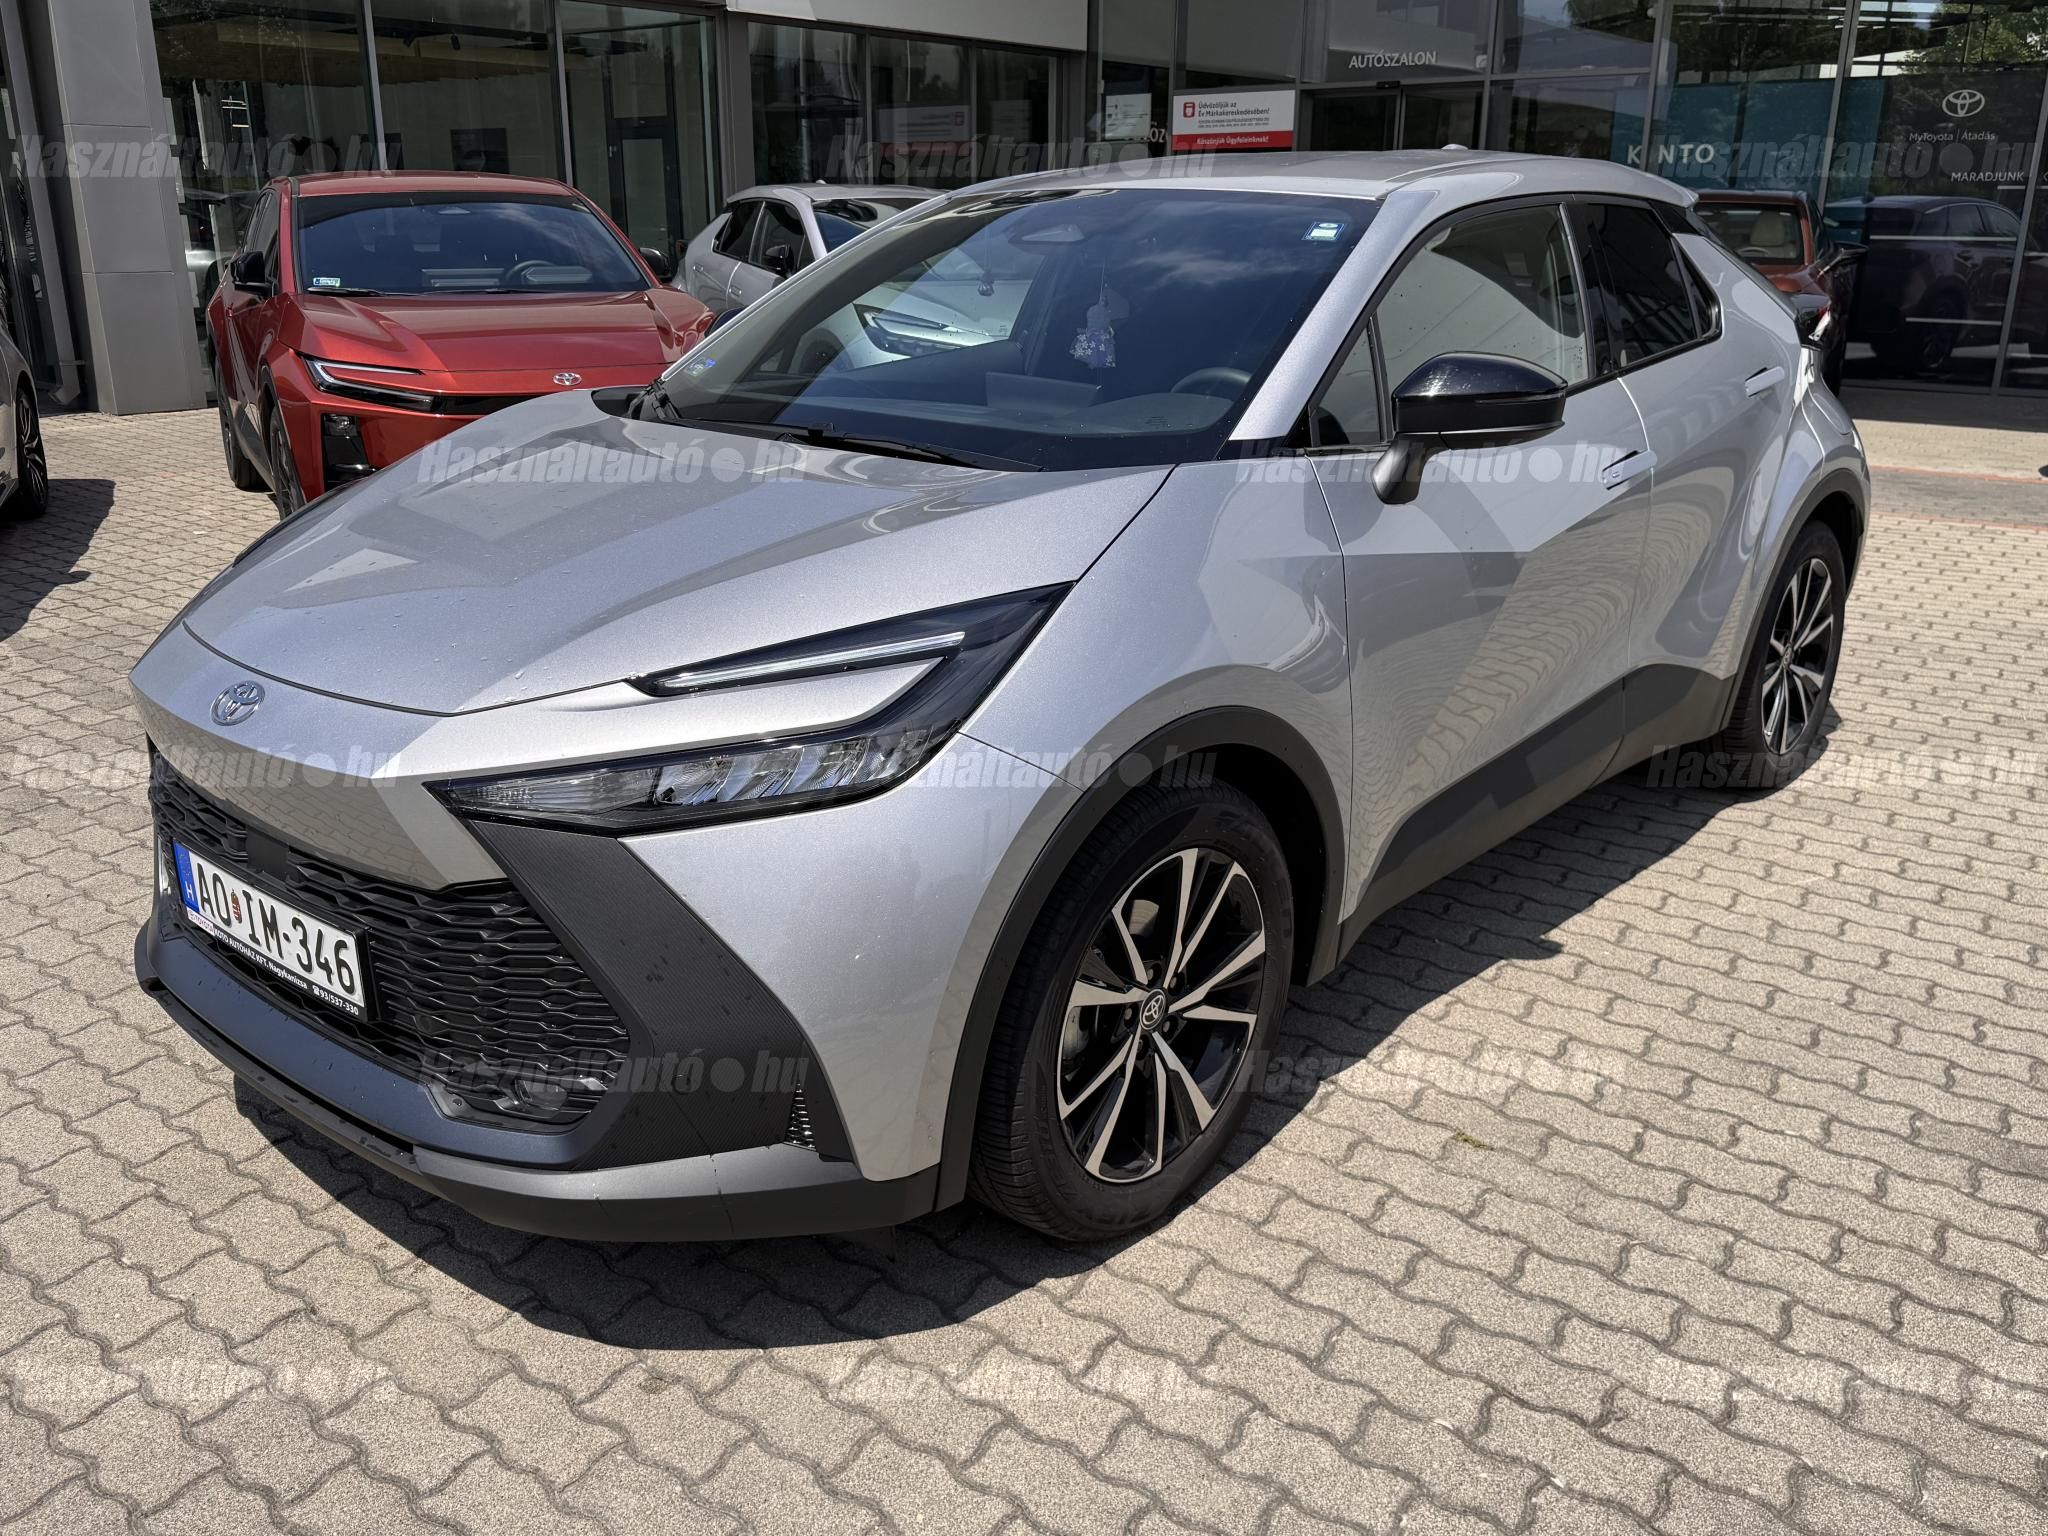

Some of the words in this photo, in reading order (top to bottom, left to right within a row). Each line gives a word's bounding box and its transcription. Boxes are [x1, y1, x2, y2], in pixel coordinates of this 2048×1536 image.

[1348, 49, 1437, 68] AUTÓSZALON
[1909, 132, 1954, 144] MyToyota
[1961, 129, 1996, 141] Átadás
[1627, 143, 1715, 164] KNTO
[1950, 170, 2025, 182] MARADJUNK
[184, 879, 195, 903] H
[197, 862, 231, 927] AO
[241, 889, 355, 995] IM-346
